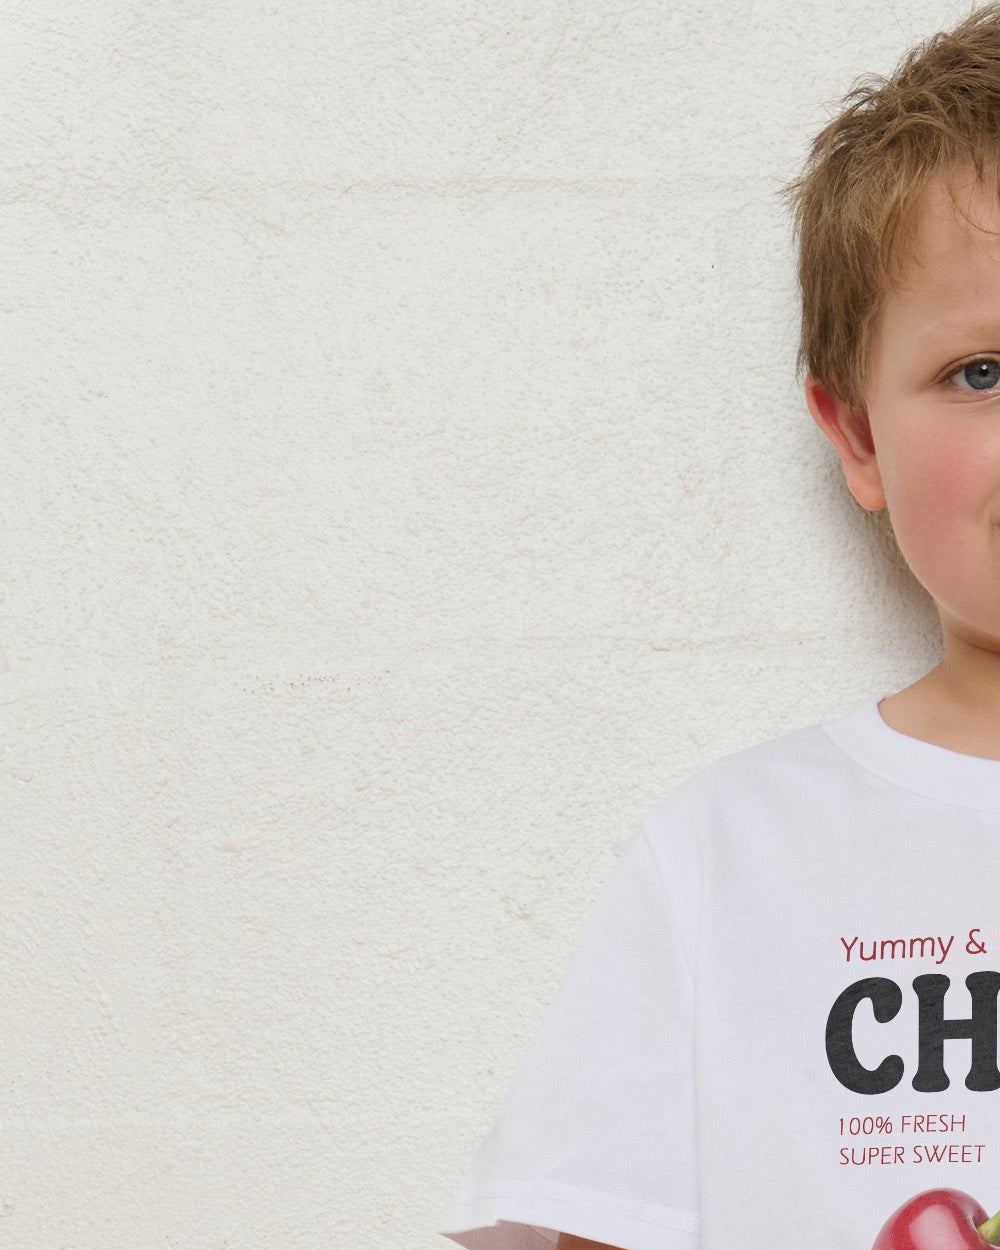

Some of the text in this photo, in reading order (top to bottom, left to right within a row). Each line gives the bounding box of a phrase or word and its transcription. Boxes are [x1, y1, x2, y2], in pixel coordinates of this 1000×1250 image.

[839, 935, 955, 965] Yummy
[965, 928, 988, 955] &
[839, 1114, 966, 1136] 100% FRESH
[839, 1144, 986, 1166] SUPER SWEET
